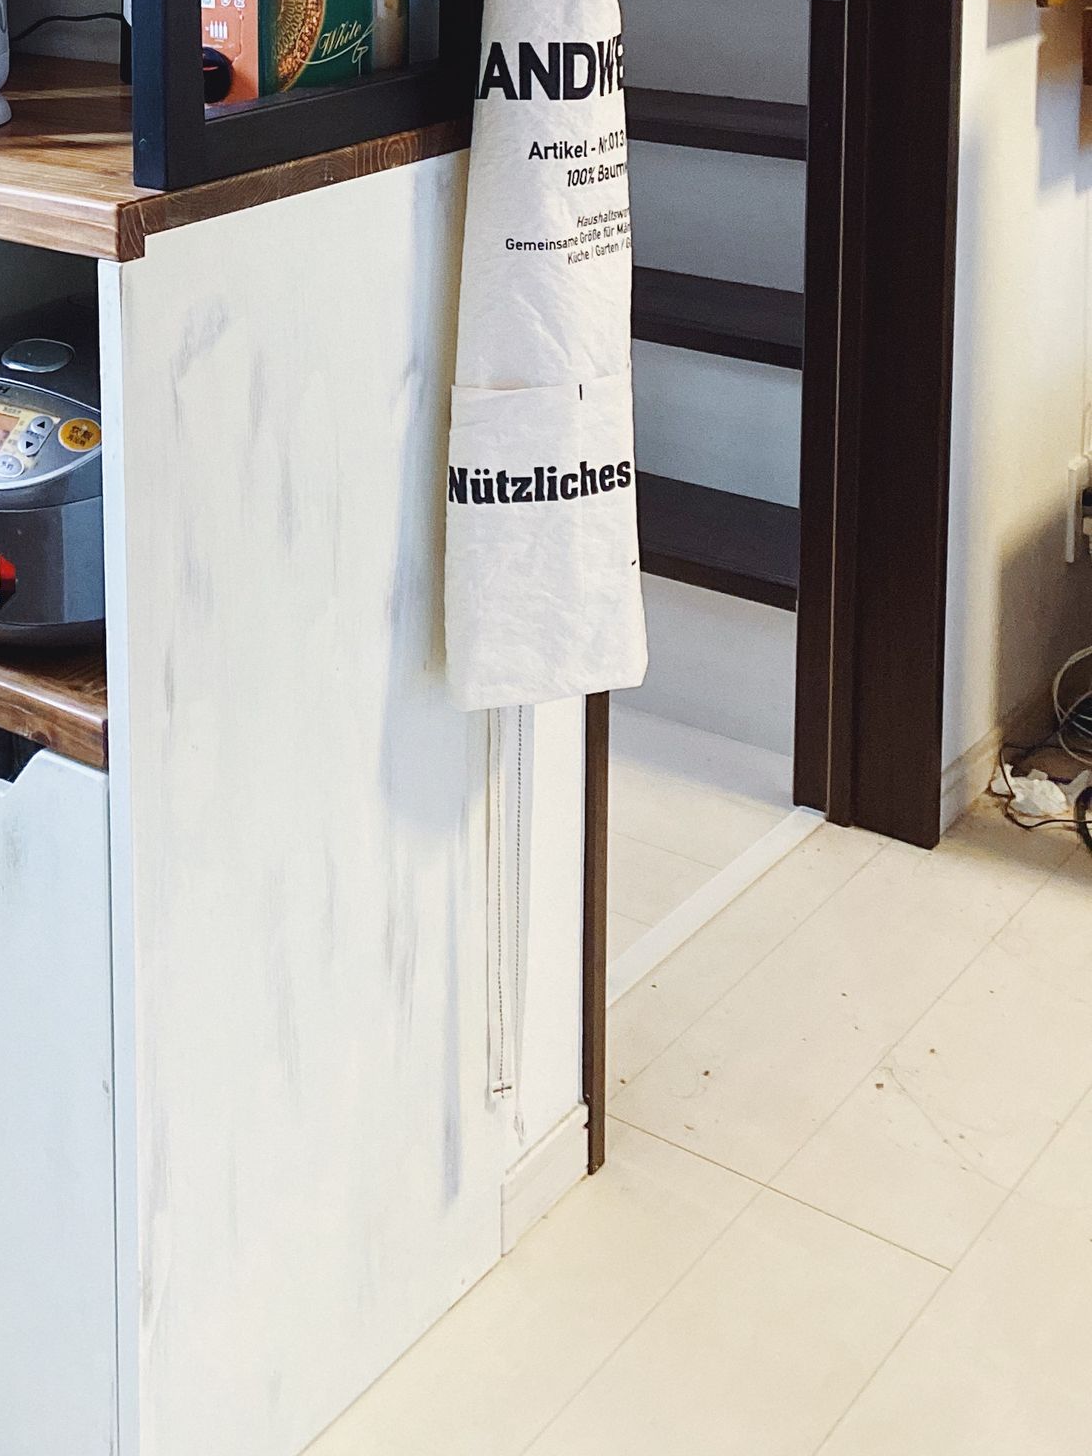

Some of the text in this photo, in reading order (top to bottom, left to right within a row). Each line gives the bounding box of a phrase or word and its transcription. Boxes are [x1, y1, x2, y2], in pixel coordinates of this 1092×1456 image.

[528, 140, 587, 160] Artikel
[567, 167, 595, 187] 100%
[506, 235, 578, 251] Gemeinsame
[580, 227, 601, 245] Größe
[603, 225, 615, 238] für
[568, 249, 590, 265] Küche
[595, 242, 619, 257] Garten
[448, 461, 631, 504] Nützliches
